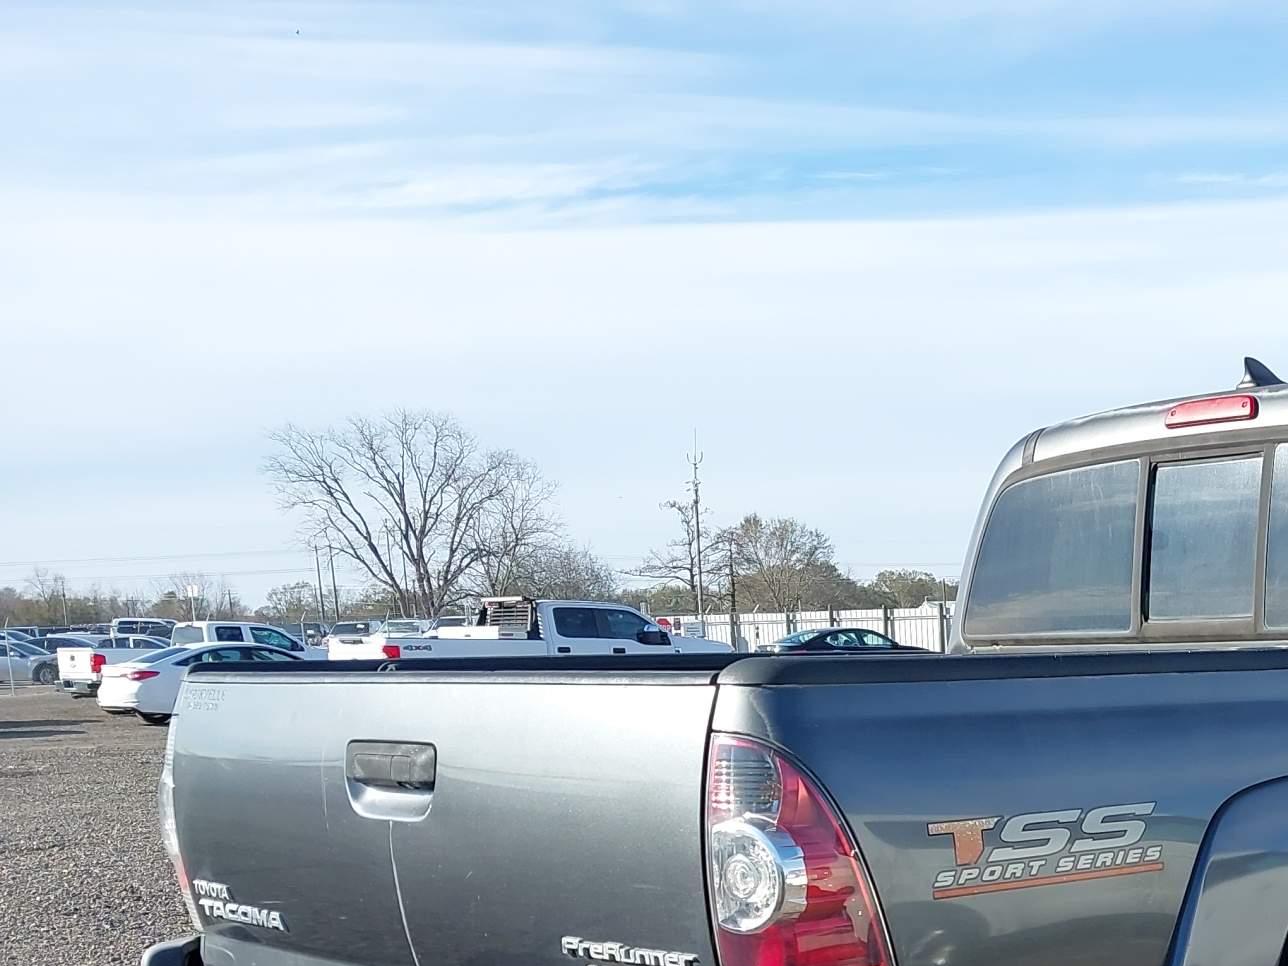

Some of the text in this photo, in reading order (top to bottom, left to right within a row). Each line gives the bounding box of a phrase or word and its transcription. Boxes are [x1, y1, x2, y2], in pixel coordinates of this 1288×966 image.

[927, 801, 1157, 867] TSS
[933, 845, 1163, 889] SPORT SERIES
[192, 879, 230, 900] TOYOTA
[199, 898, 285, 931] TACOMA
